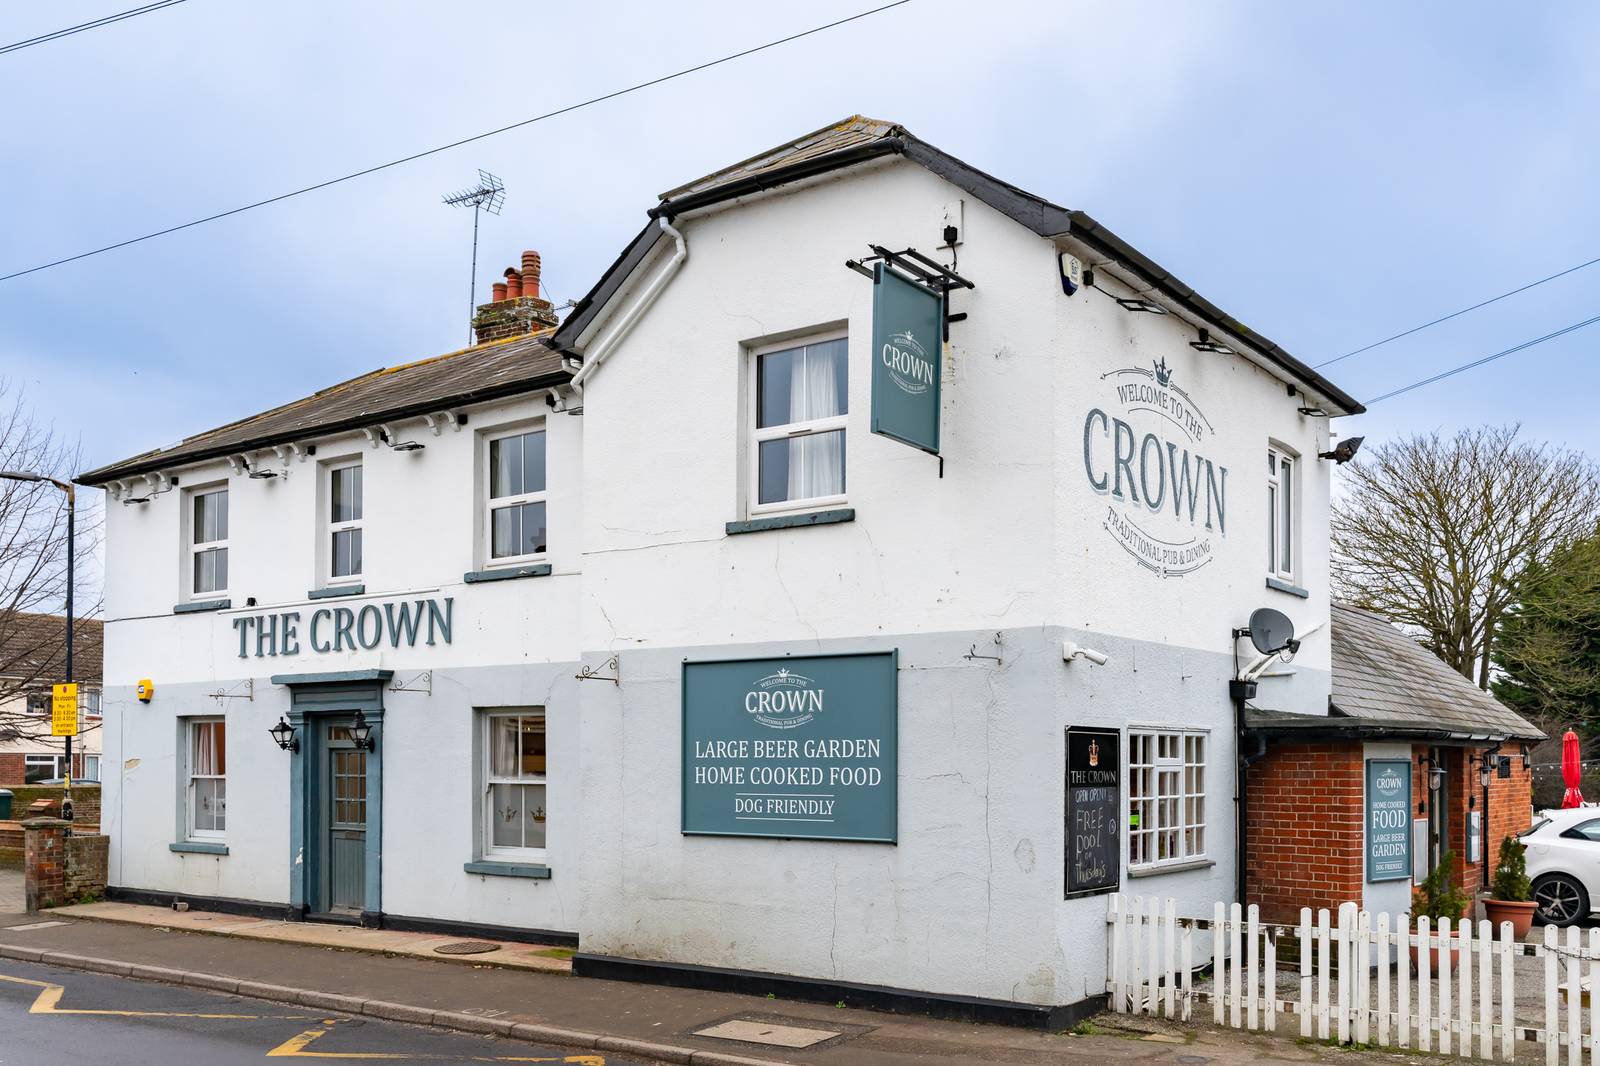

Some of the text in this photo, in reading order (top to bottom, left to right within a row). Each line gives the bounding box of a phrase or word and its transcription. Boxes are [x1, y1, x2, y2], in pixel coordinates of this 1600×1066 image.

[882, 343, 933, 385] CROWN
[1117, 383, 1204, 442] WELCOME TO THE
[1083, 407, 1229, 538] CROWN
[1107, 505, 1212, 565] TRADITIONAL PUB & DINING
[232, 597, 454, 659] THE CROWN
[760, 677, 787, 688] WELCOME
[796, 678, 808, 688] THE
[745, 689, 824, 713] CROWN
[695, 739, 881, 759] LARGE BEER GARDEN
[695, 766, 882, 786] HOME COOKED FOOD
[1070, 770, 1117, 784] THE CROWN
[1376, 777, 1402, 790] CROWN
[735, 798, 835, 815] DOG FRIENDLY
[1372, 801, 1406, 809] HOME COOKED
[1076, 807, 1104, 831] FREE
[1372, 810, 1406, 829] FOOD
[1373, 832, 1406, 843] LARGE BEER
[1372, 844, 1406, 858] GARDEN
